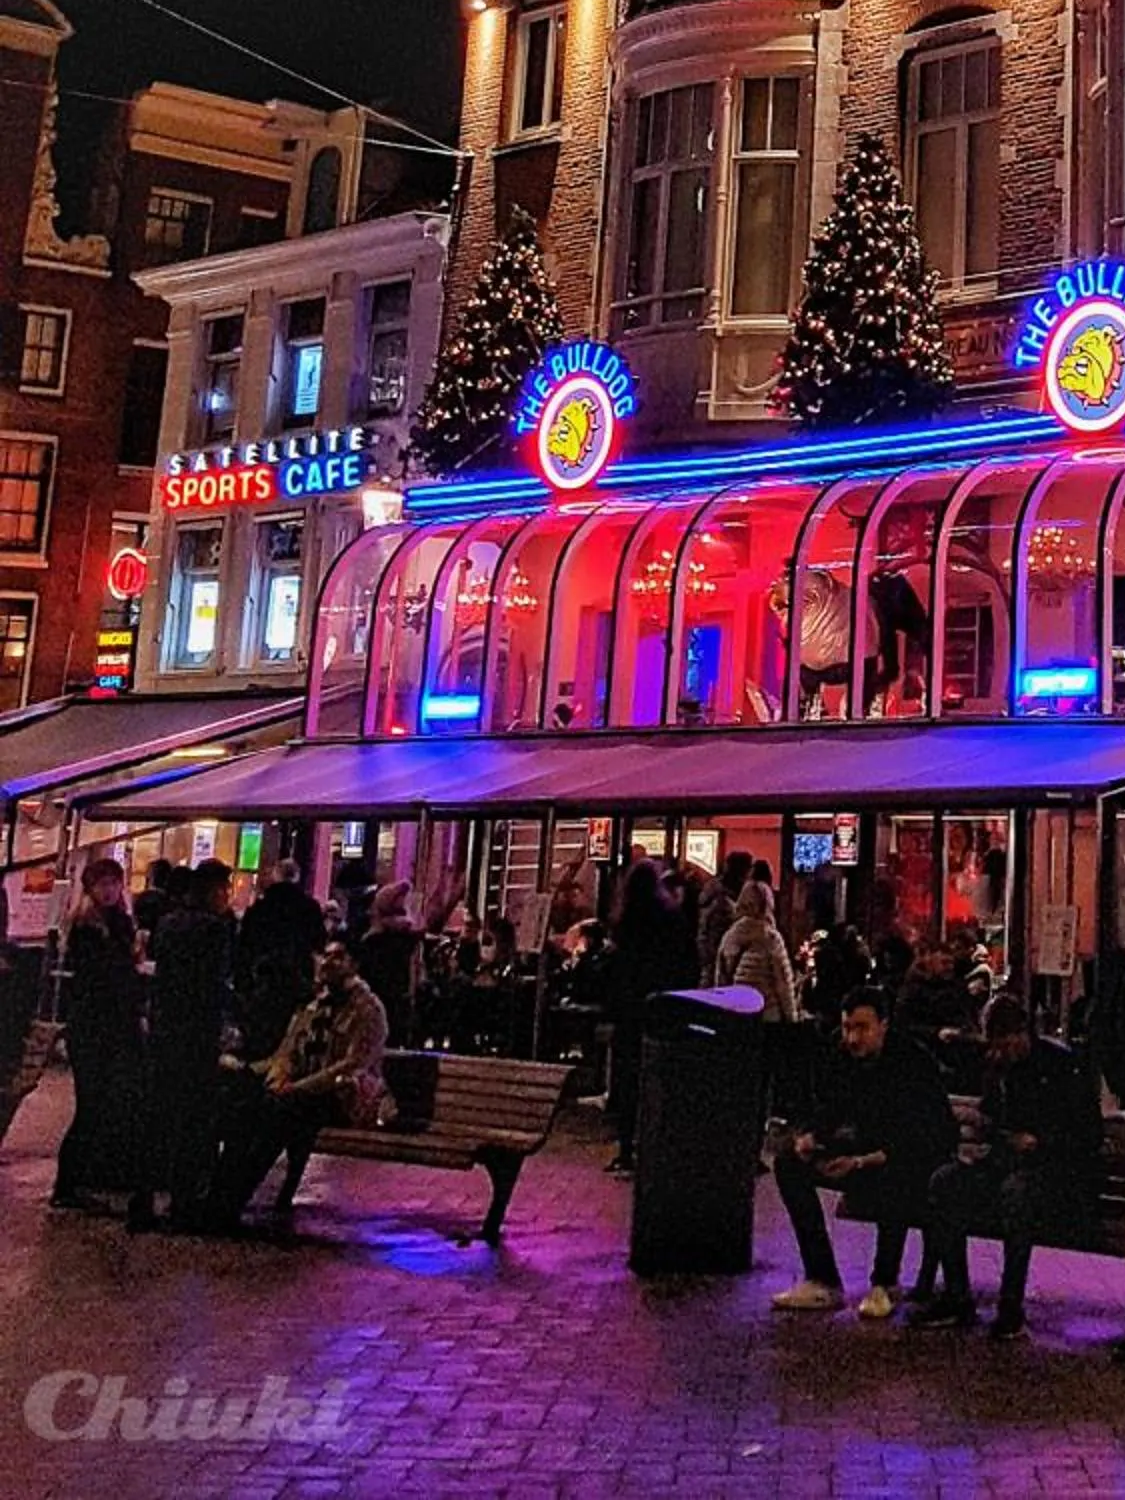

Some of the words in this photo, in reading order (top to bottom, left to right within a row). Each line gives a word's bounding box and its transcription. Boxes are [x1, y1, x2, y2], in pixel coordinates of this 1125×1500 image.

[1015, 298, 1059, 367] THE
[516, 373, 555, 434] THE
[551, 343, 634, 419] BULLDOG
[166, 468, 271, 508] SPORTS
[285, 455, 362, 495] CAFE
[168, 427, 365, 476] SATELLITE
